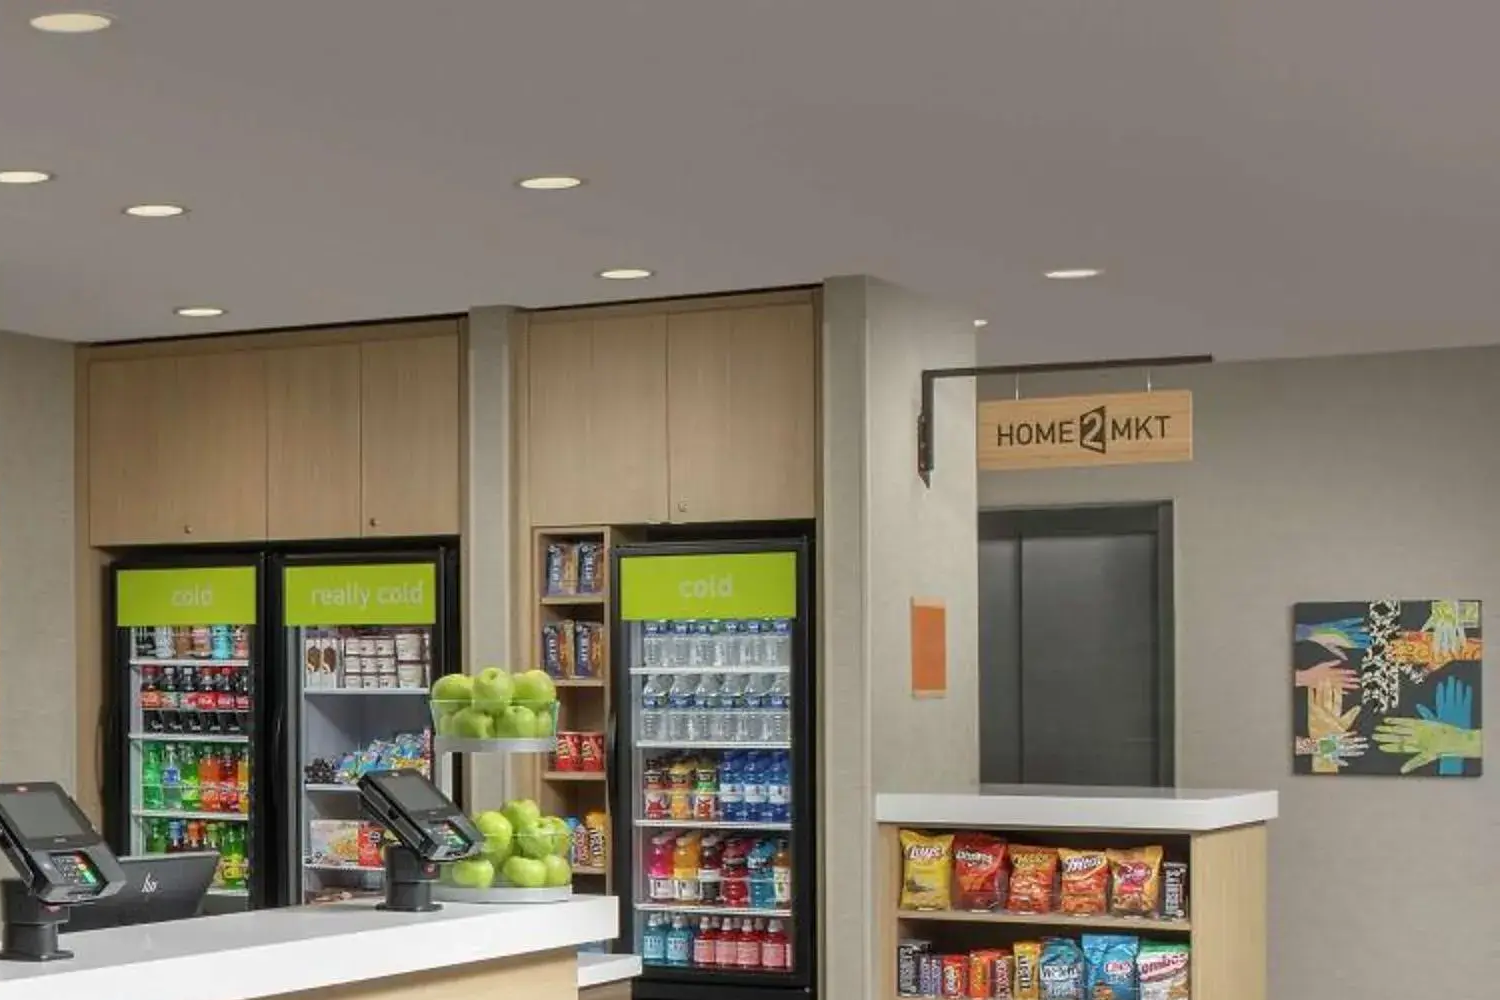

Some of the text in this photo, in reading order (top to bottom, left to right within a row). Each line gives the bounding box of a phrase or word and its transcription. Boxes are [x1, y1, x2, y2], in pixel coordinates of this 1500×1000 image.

[171, 583, 213, 608] cold
[311, 579, 423, 609] really cold
[679, 573, 734, 598] cold
